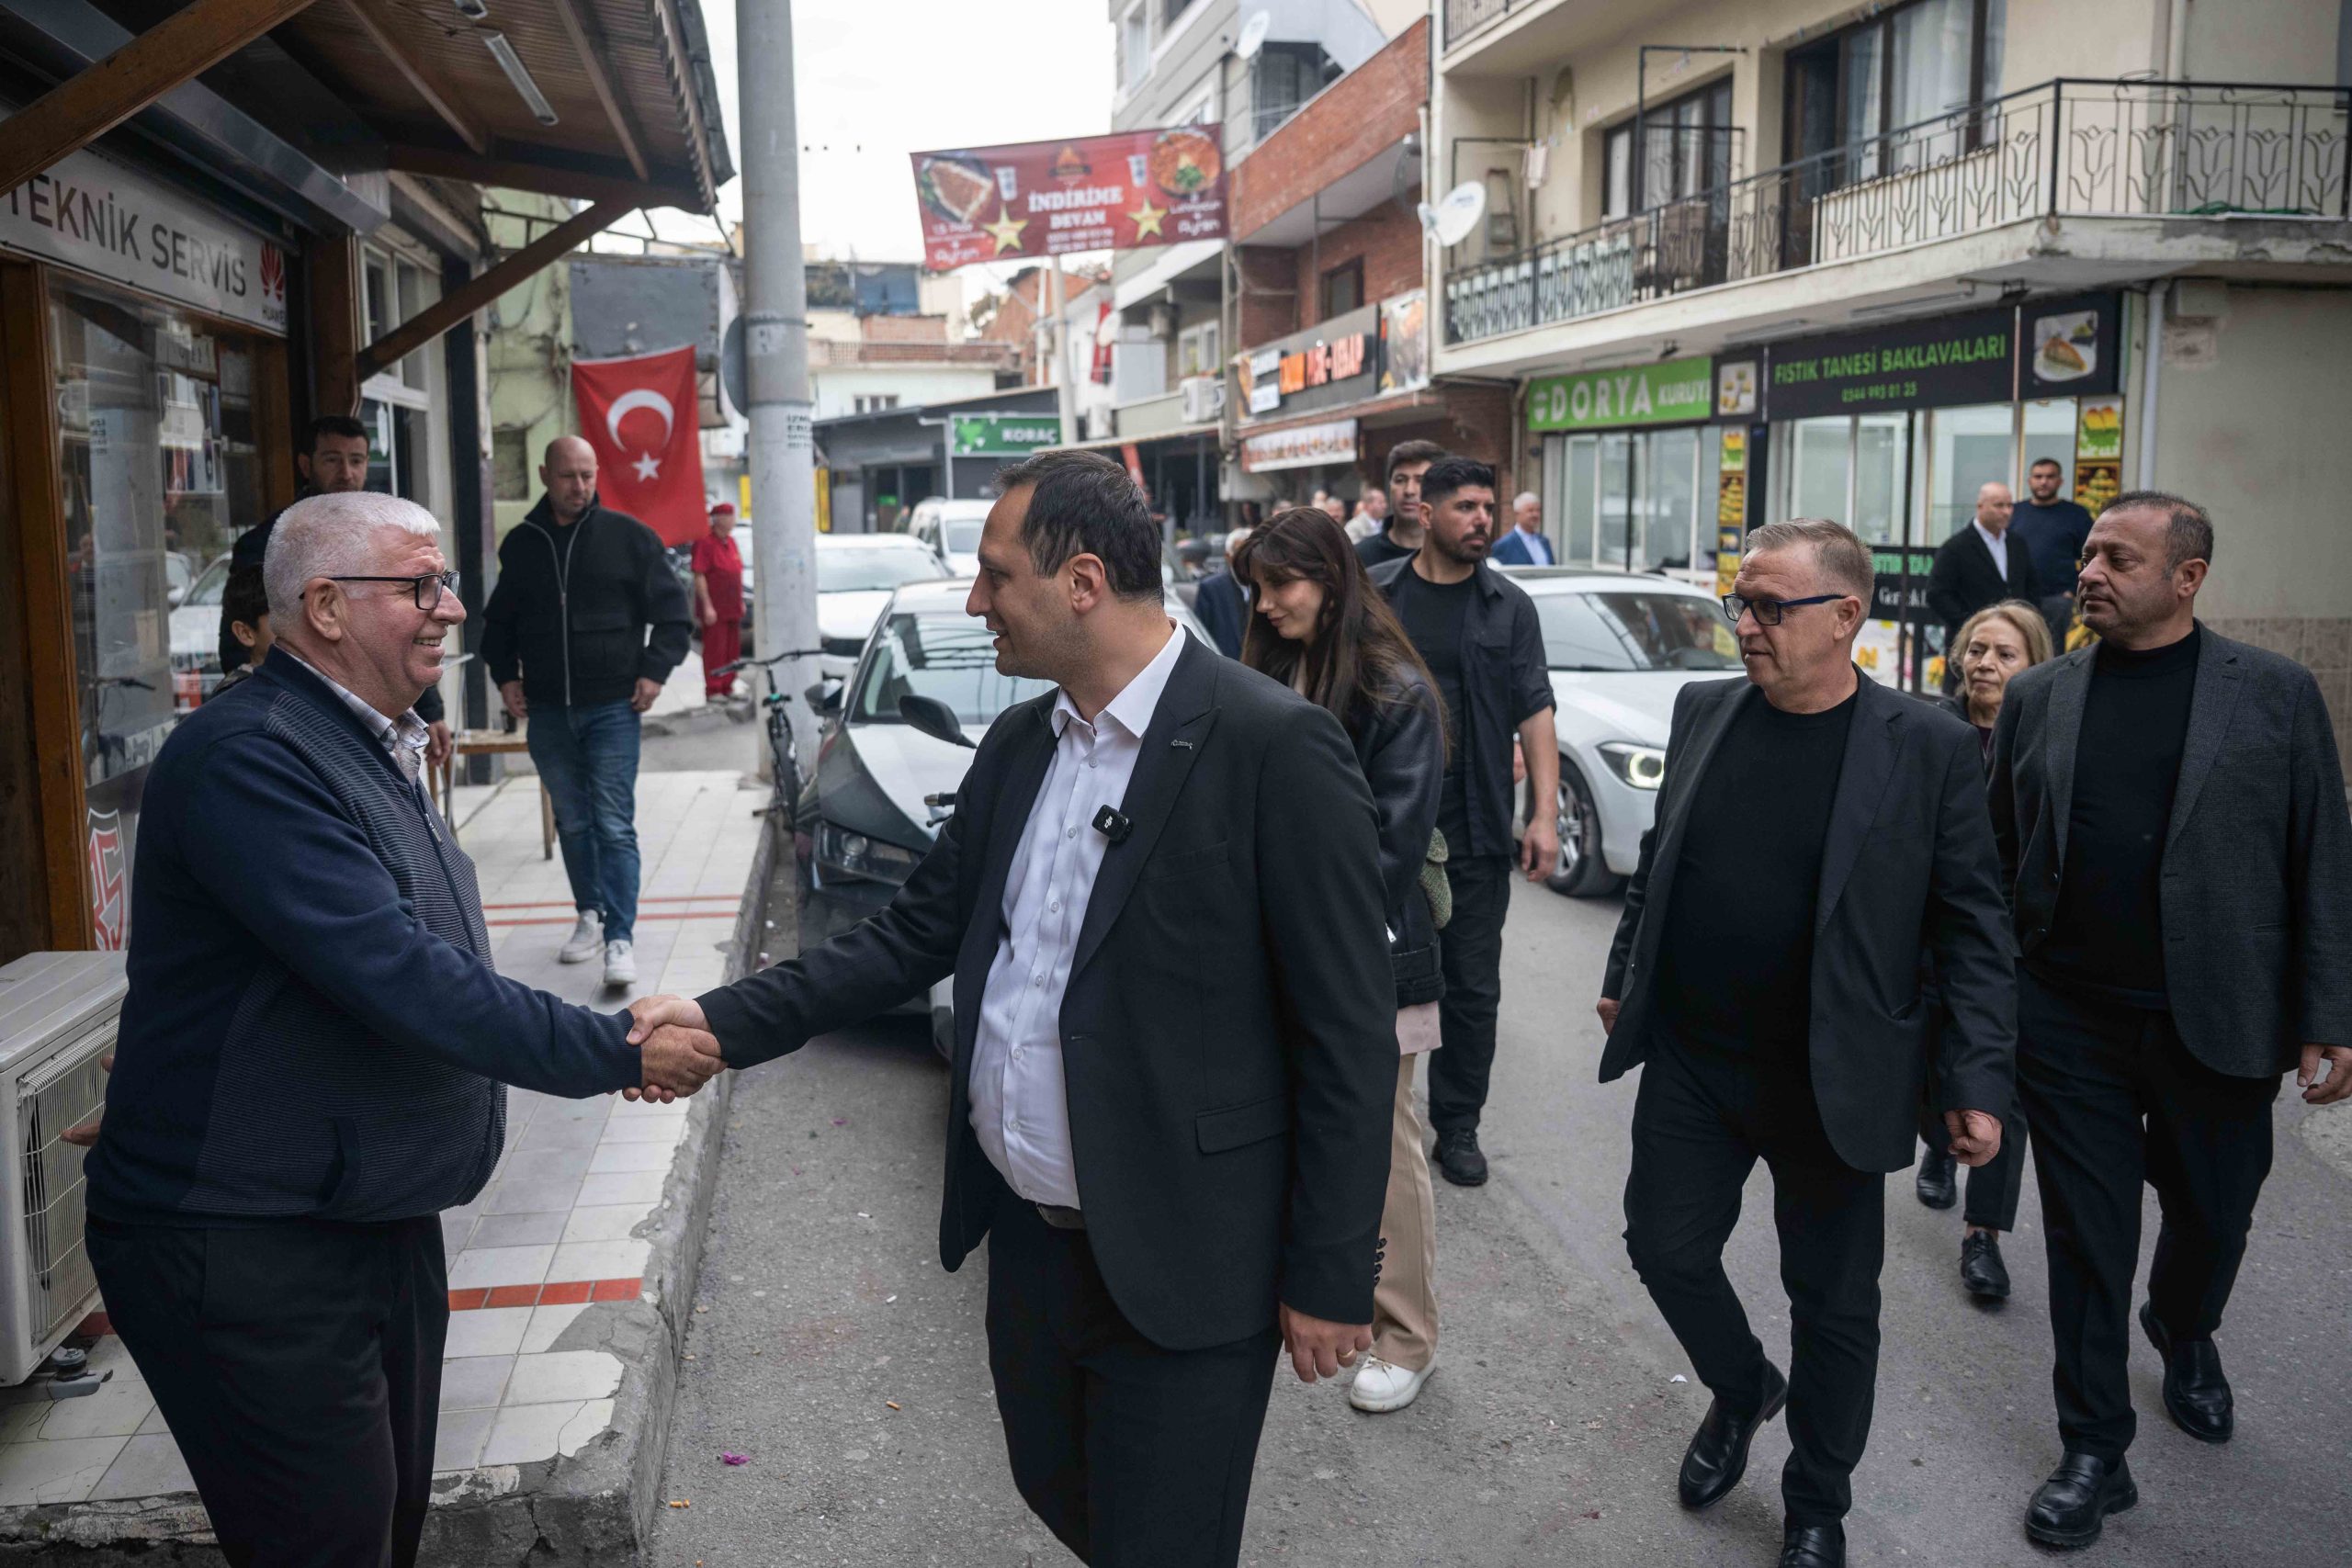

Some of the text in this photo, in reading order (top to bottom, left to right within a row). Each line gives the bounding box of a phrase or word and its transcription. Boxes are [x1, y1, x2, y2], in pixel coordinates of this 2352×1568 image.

[1027, 186, 1124, 213] İNDİRİME
[1049, 210, 1106, 230] DEVAM
[151, 222, 247, 297] SERVİS
[1774, 333, 2007, 385] FISTIK TANESİ BAKLAVALARI
[1551, 375, 1652, 423] DORYA
[1001, 427, 1057, 445] KORAÇ
